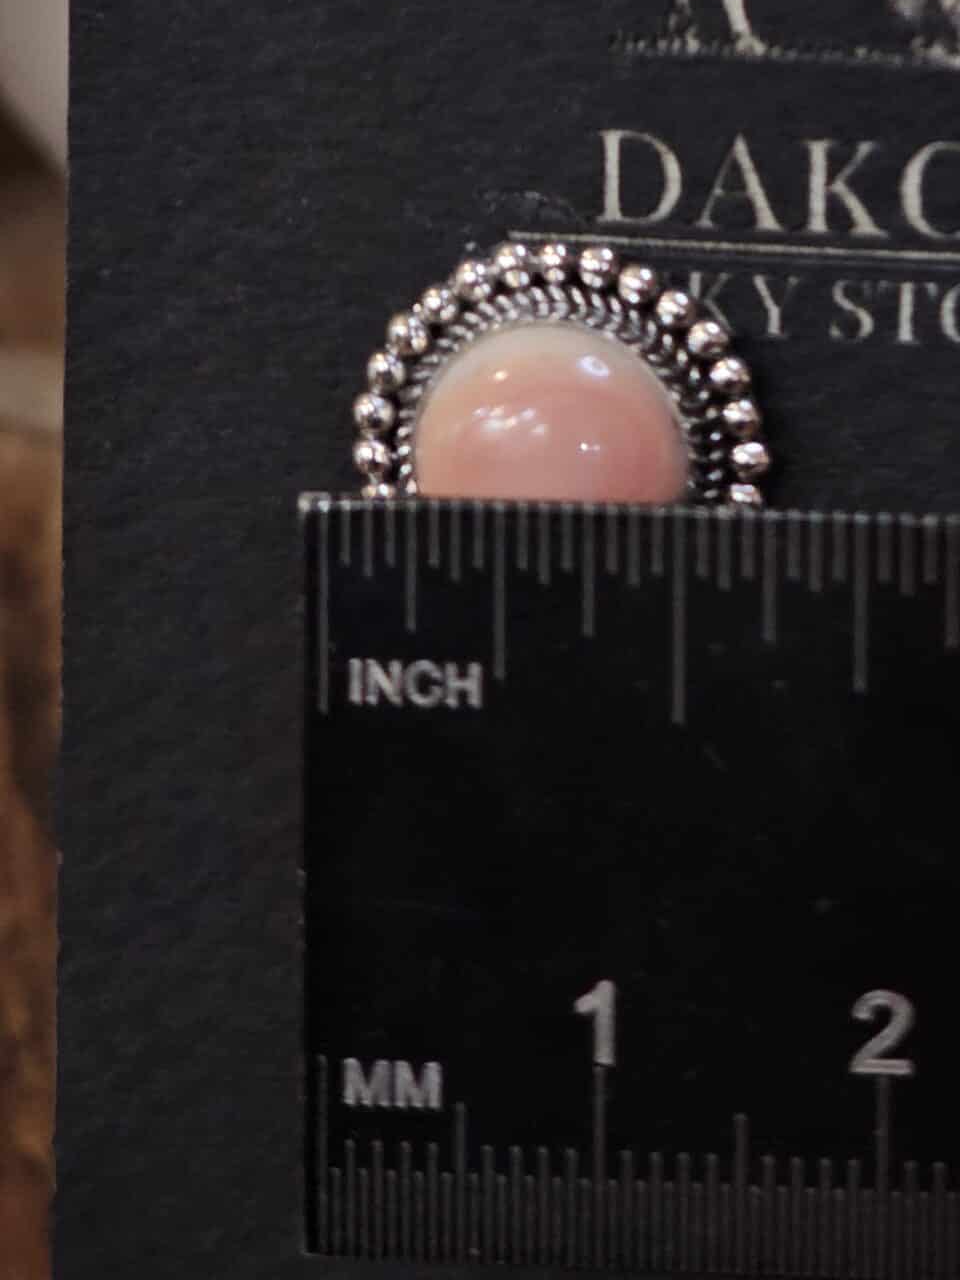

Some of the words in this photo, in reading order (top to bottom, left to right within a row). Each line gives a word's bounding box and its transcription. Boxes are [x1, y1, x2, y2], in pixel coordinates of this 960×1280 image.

[686, 270, 799, 340] KY
[346, 658, 484, 710] INCH
[573, 979, 617, 1067] 1
[849, 989, 916, 1076] 2
[342, 1057, 443, 1110] MM
